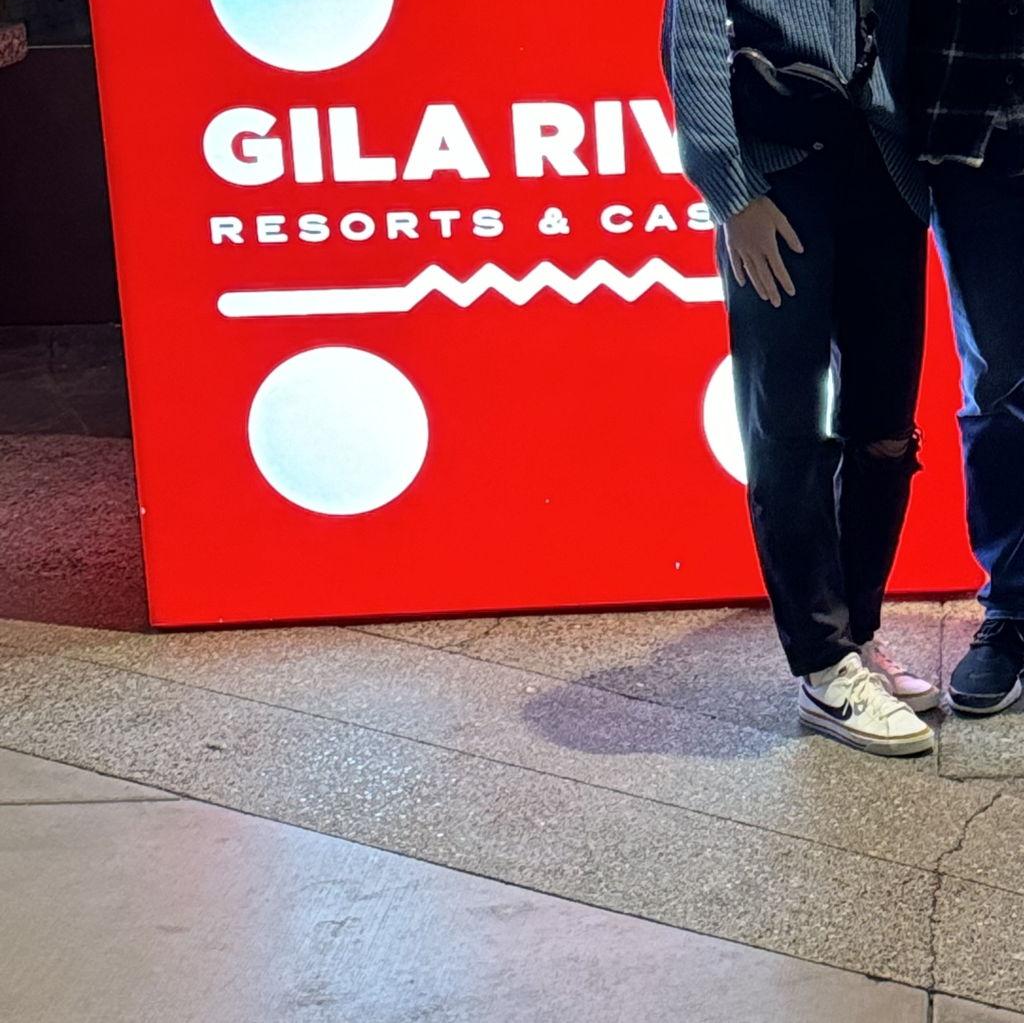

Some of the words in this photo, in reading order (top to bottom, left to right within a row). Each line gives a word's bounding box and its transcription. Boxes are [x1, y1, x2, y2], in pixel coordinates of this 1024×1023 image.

[203, 104, 490, 185] GILA
[209, 208, 504, 245] RESORTS
[538, 206, 570, 235] &
